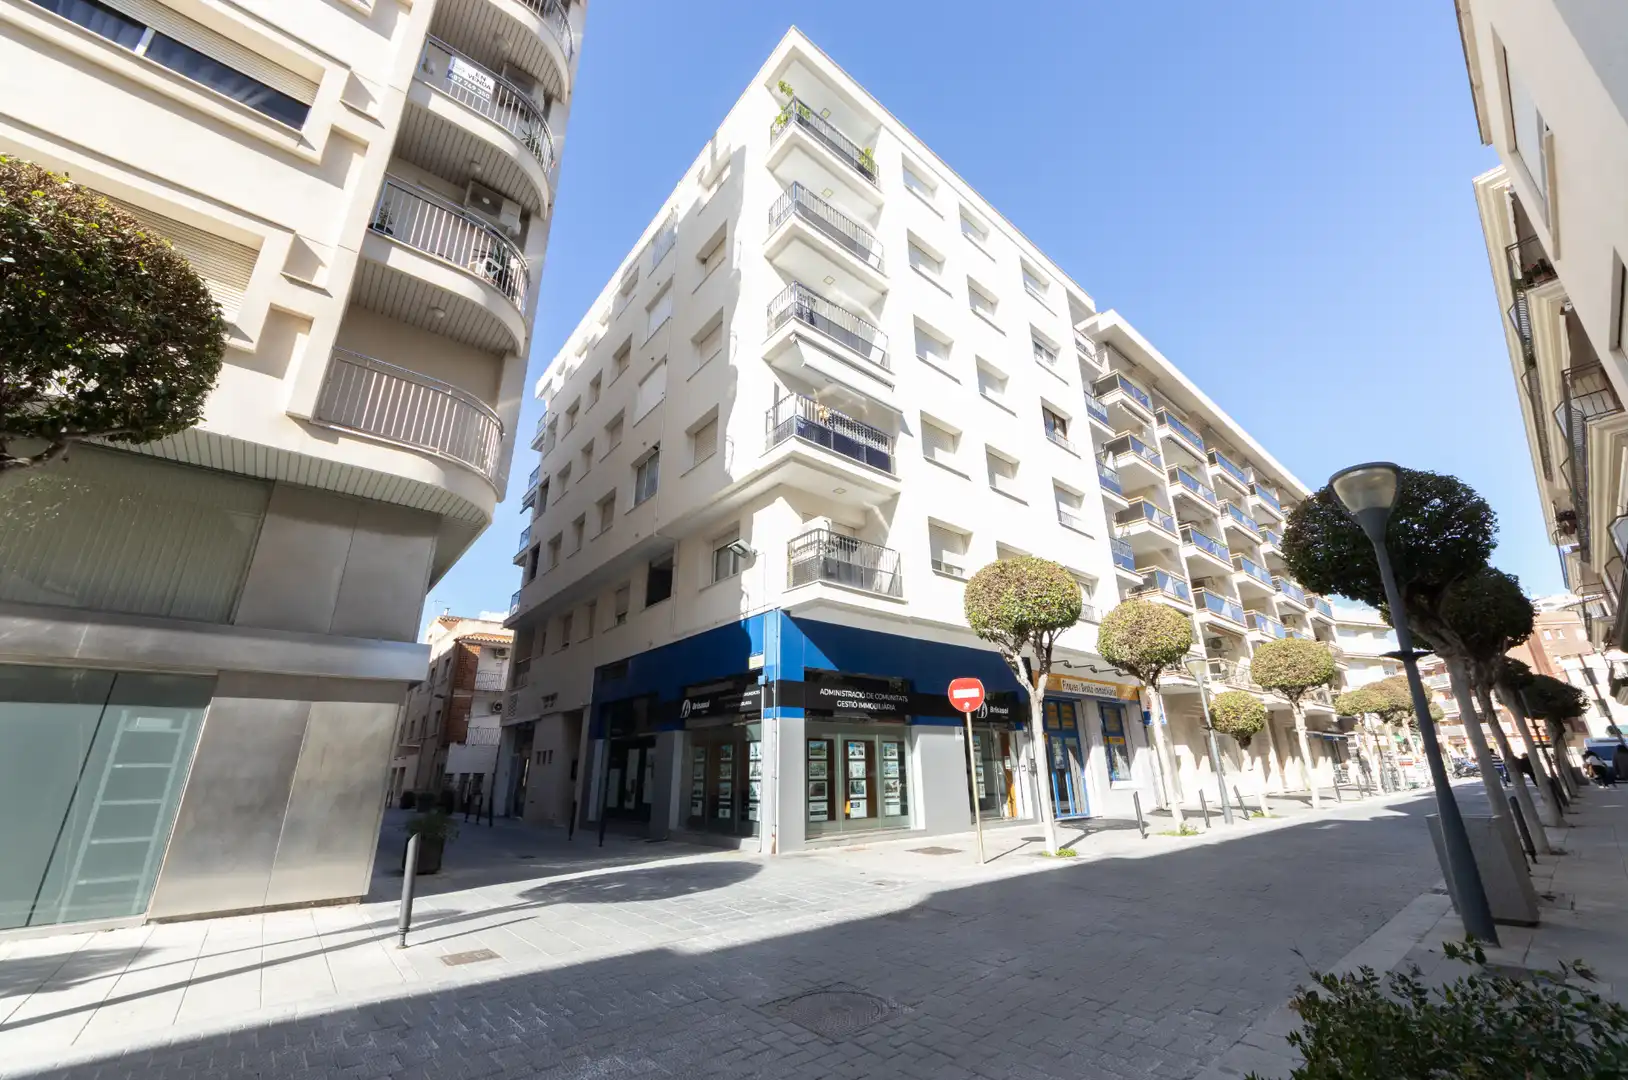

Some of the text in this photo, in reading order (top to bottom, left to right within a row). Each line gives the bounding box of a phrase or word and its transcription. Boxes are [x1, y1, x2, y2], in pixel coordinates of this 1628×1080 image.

[467, 73, 491, 90] VENDA
[475, 72, 486, 82] EN
[819, 688, 909, 703] ADMINISTRACIÓ DE COMUNITATS
[836, 700, 858, 709] GESTIÓ
